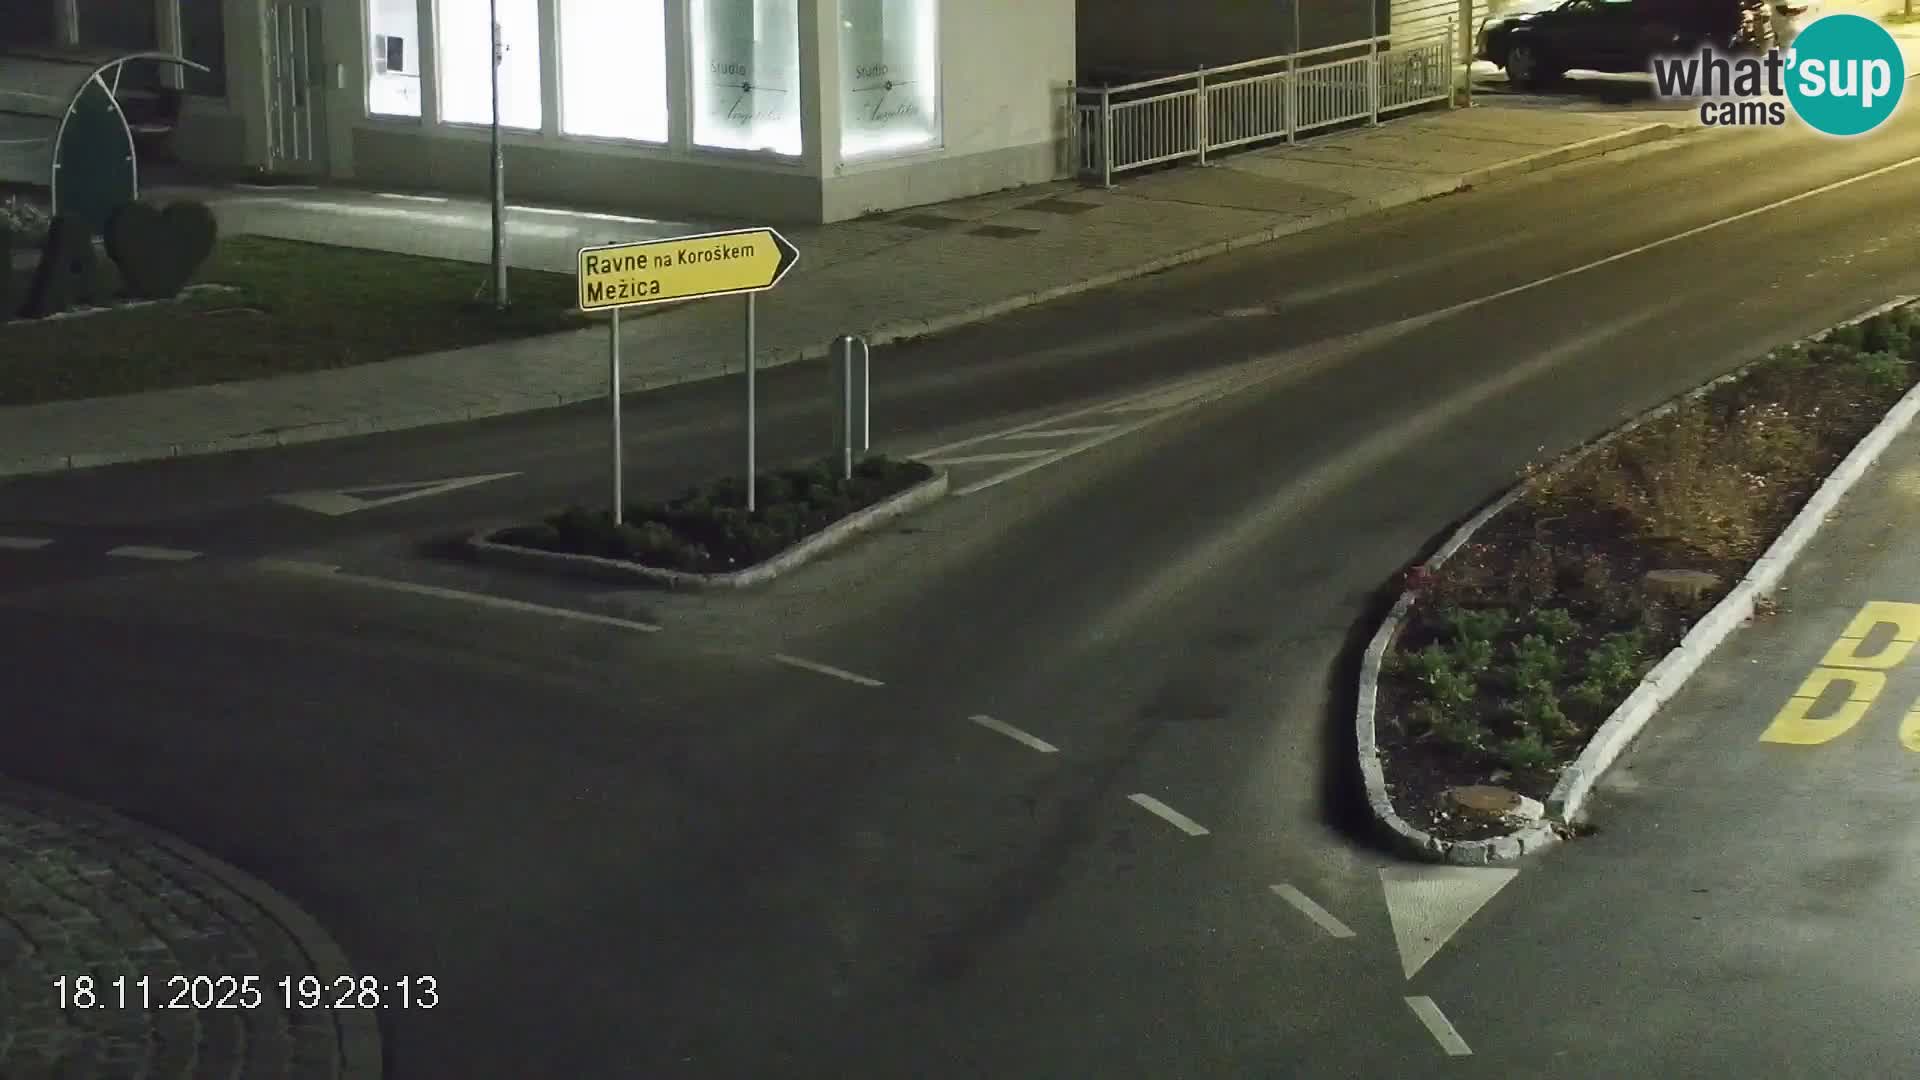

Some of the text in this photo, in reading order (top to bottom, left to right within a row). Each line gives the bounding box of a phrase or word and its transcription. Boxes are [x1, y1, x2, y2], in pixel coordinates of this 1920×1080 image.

[586, 244, 755, 276] Ravne na Koroškem
[586, 279, 661, 302] Mežica
